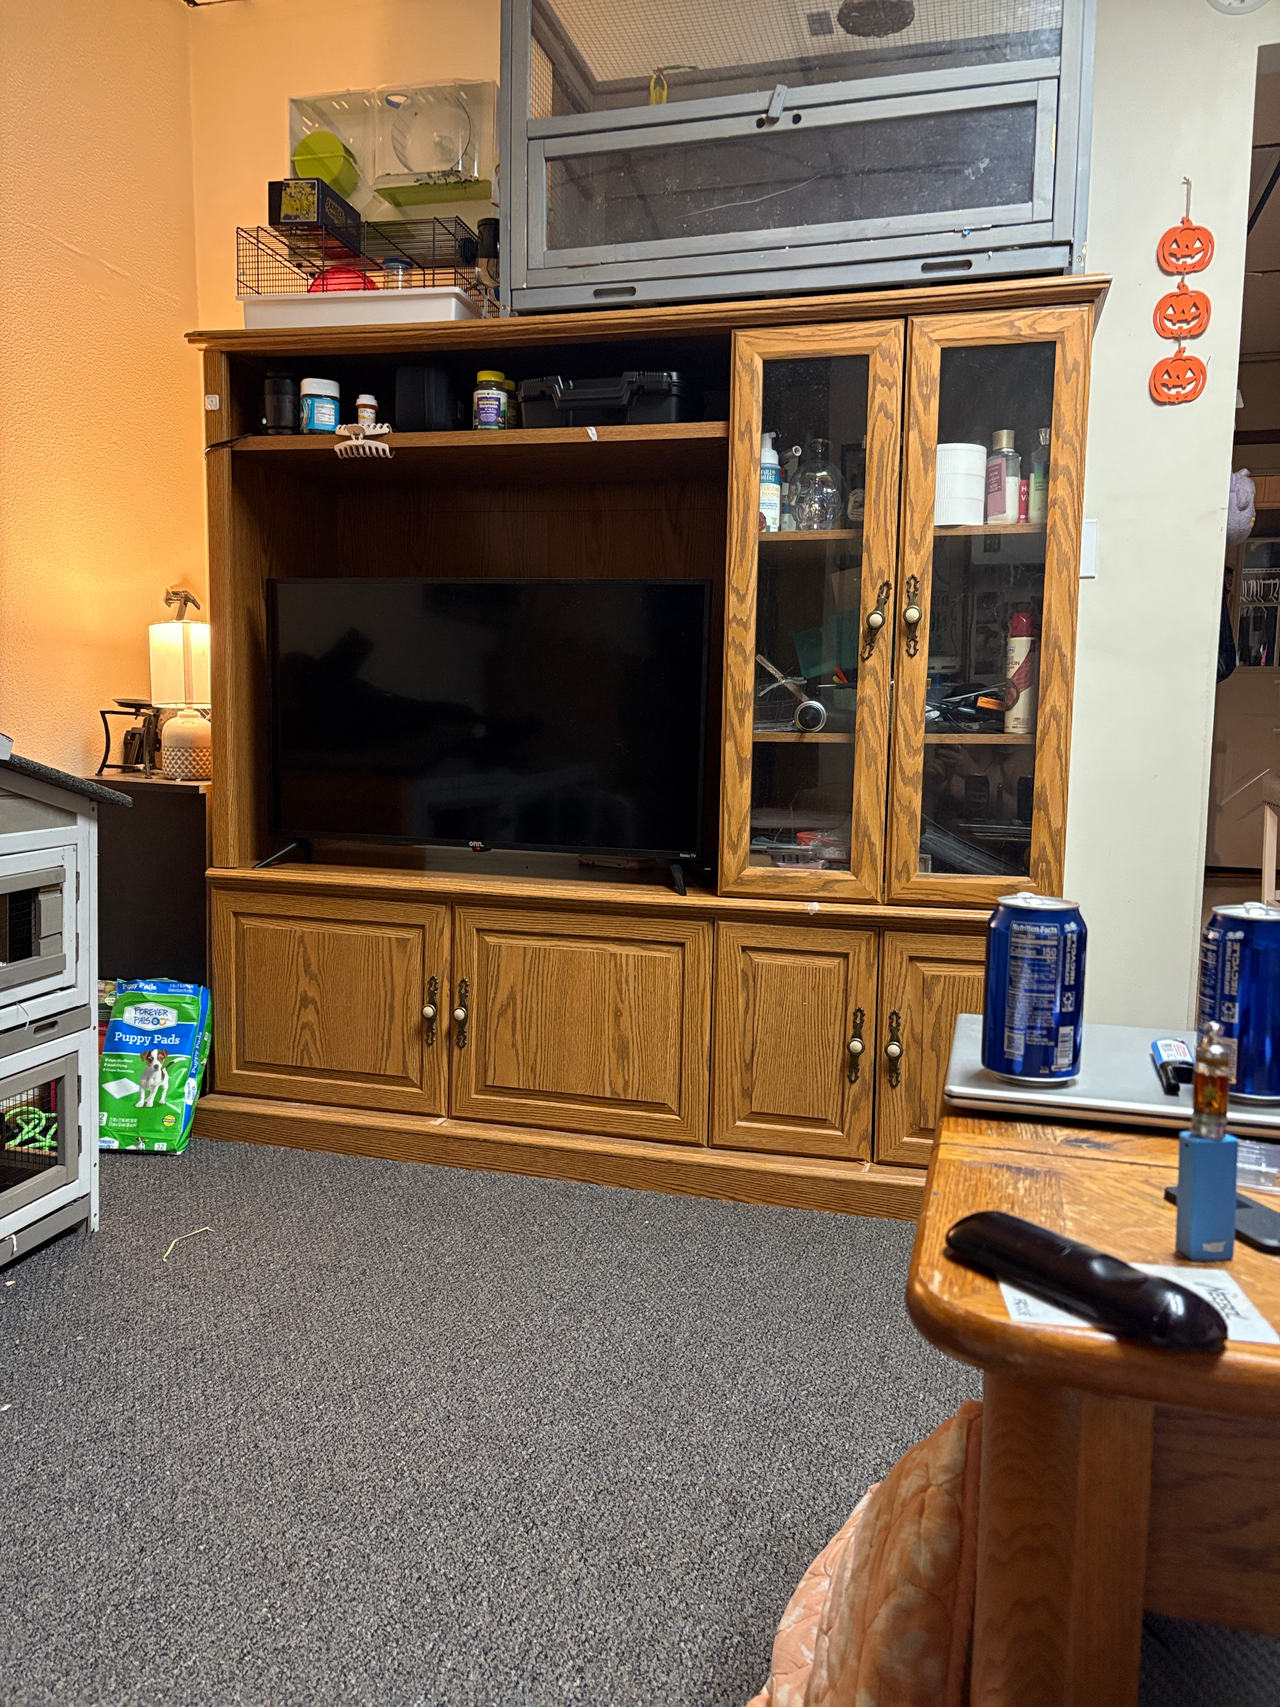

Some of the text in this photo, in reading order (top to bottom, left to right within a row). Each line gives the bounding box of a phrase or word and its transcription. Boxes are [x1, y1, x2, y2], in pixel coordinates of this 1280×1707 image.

[1012, 923, 1058, 934] Nutrition Facts
[1069, 933, 1078, 986] RECYCLE
[1231, 941, 1240, 996] RECYCLE
[133, 1006, 168, 1017] FOREVER
[133, 1016, 151, 1025] PALS
[114, 1032, 180, 1046] Puppy Pads
[191, 1050, 199, 1074] Puppy
[195, 1031, 203, 1049] Pads
